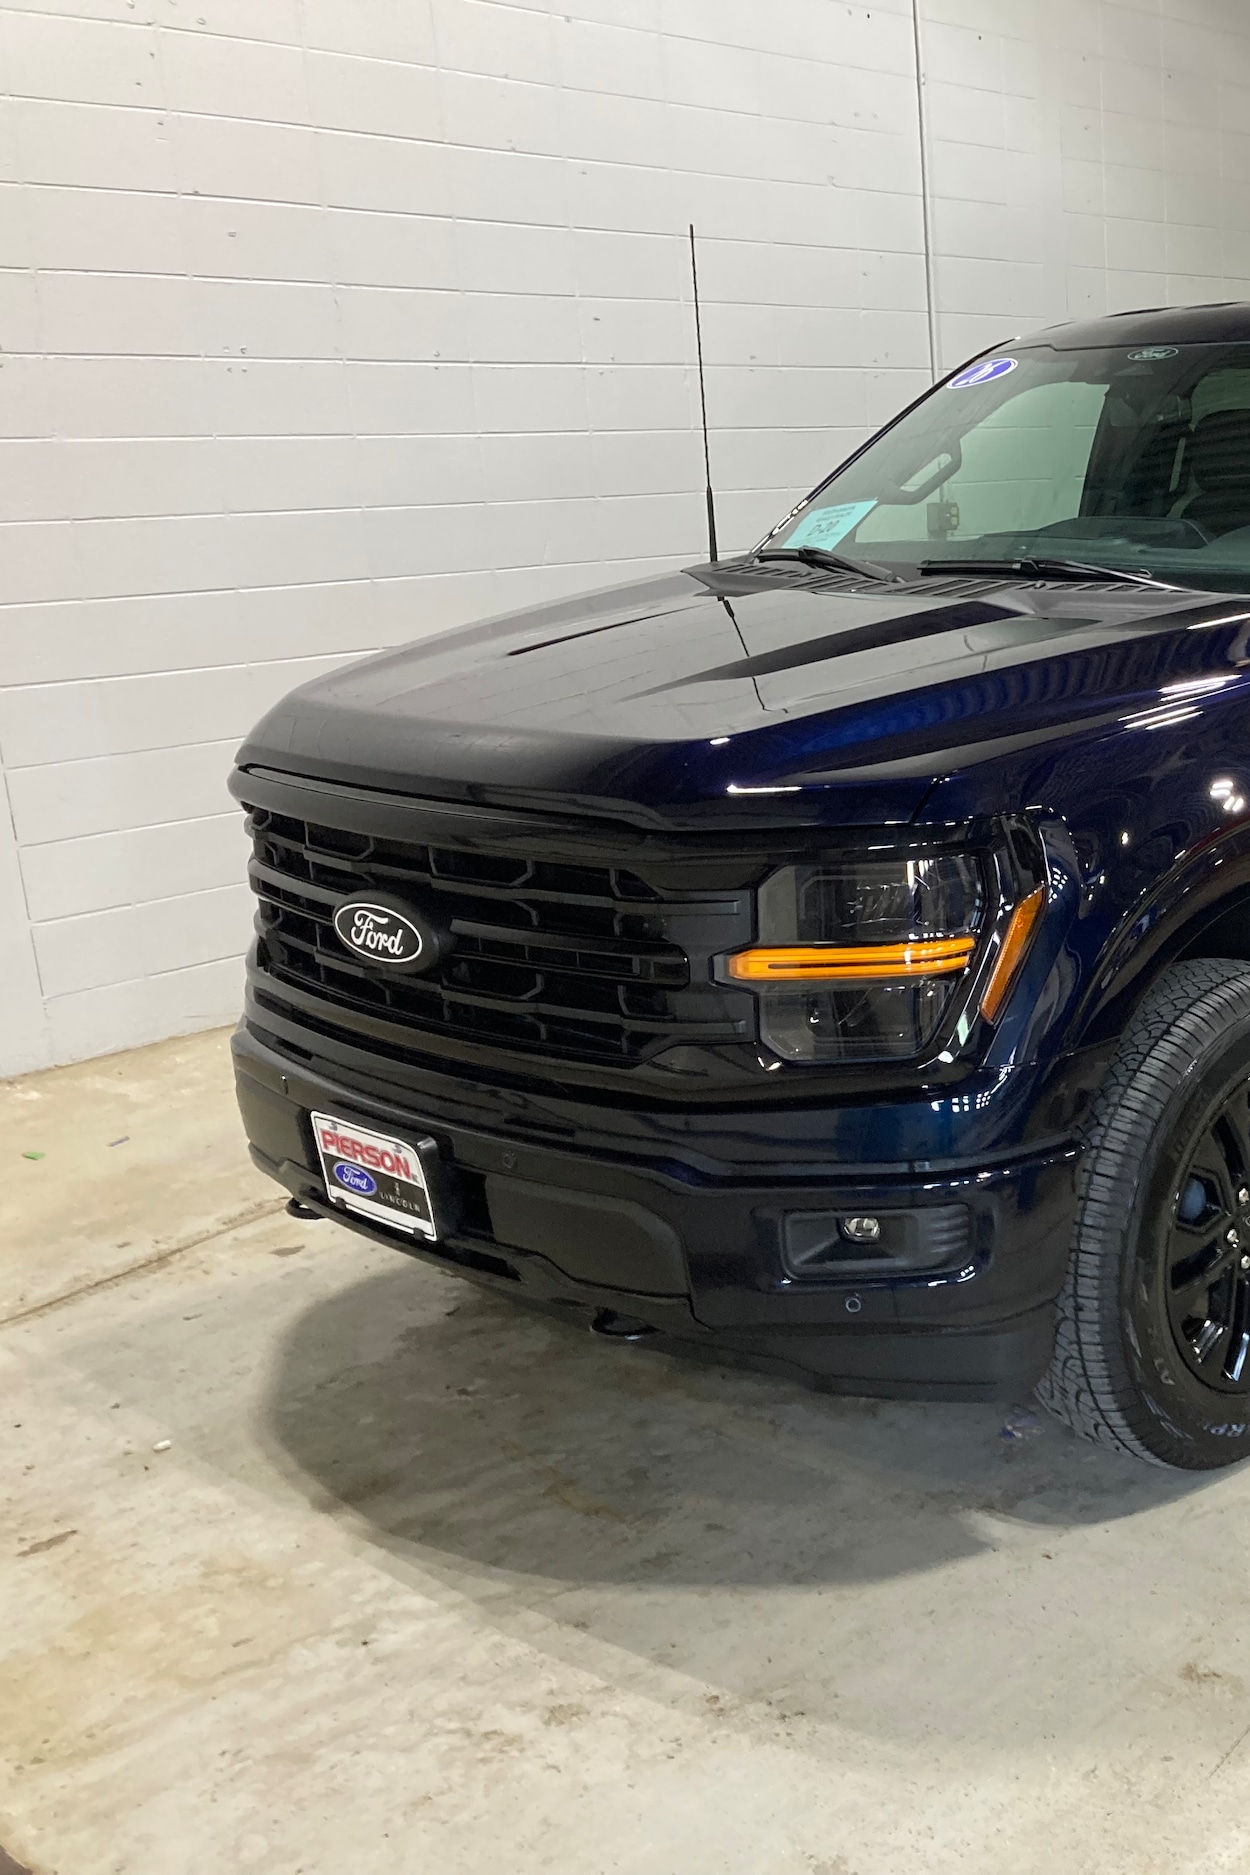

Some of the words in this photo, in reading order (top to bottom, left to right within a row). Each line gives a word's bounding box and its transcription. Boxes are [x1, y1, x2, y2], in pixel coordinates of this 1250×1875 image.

[350, 909, 404, 956] Ford
[320, 1128, 412, 1181] PIERSON
[342, 1166, 368, 1190] Ford
[380, 1191, 420, 1213] LINCOLN
